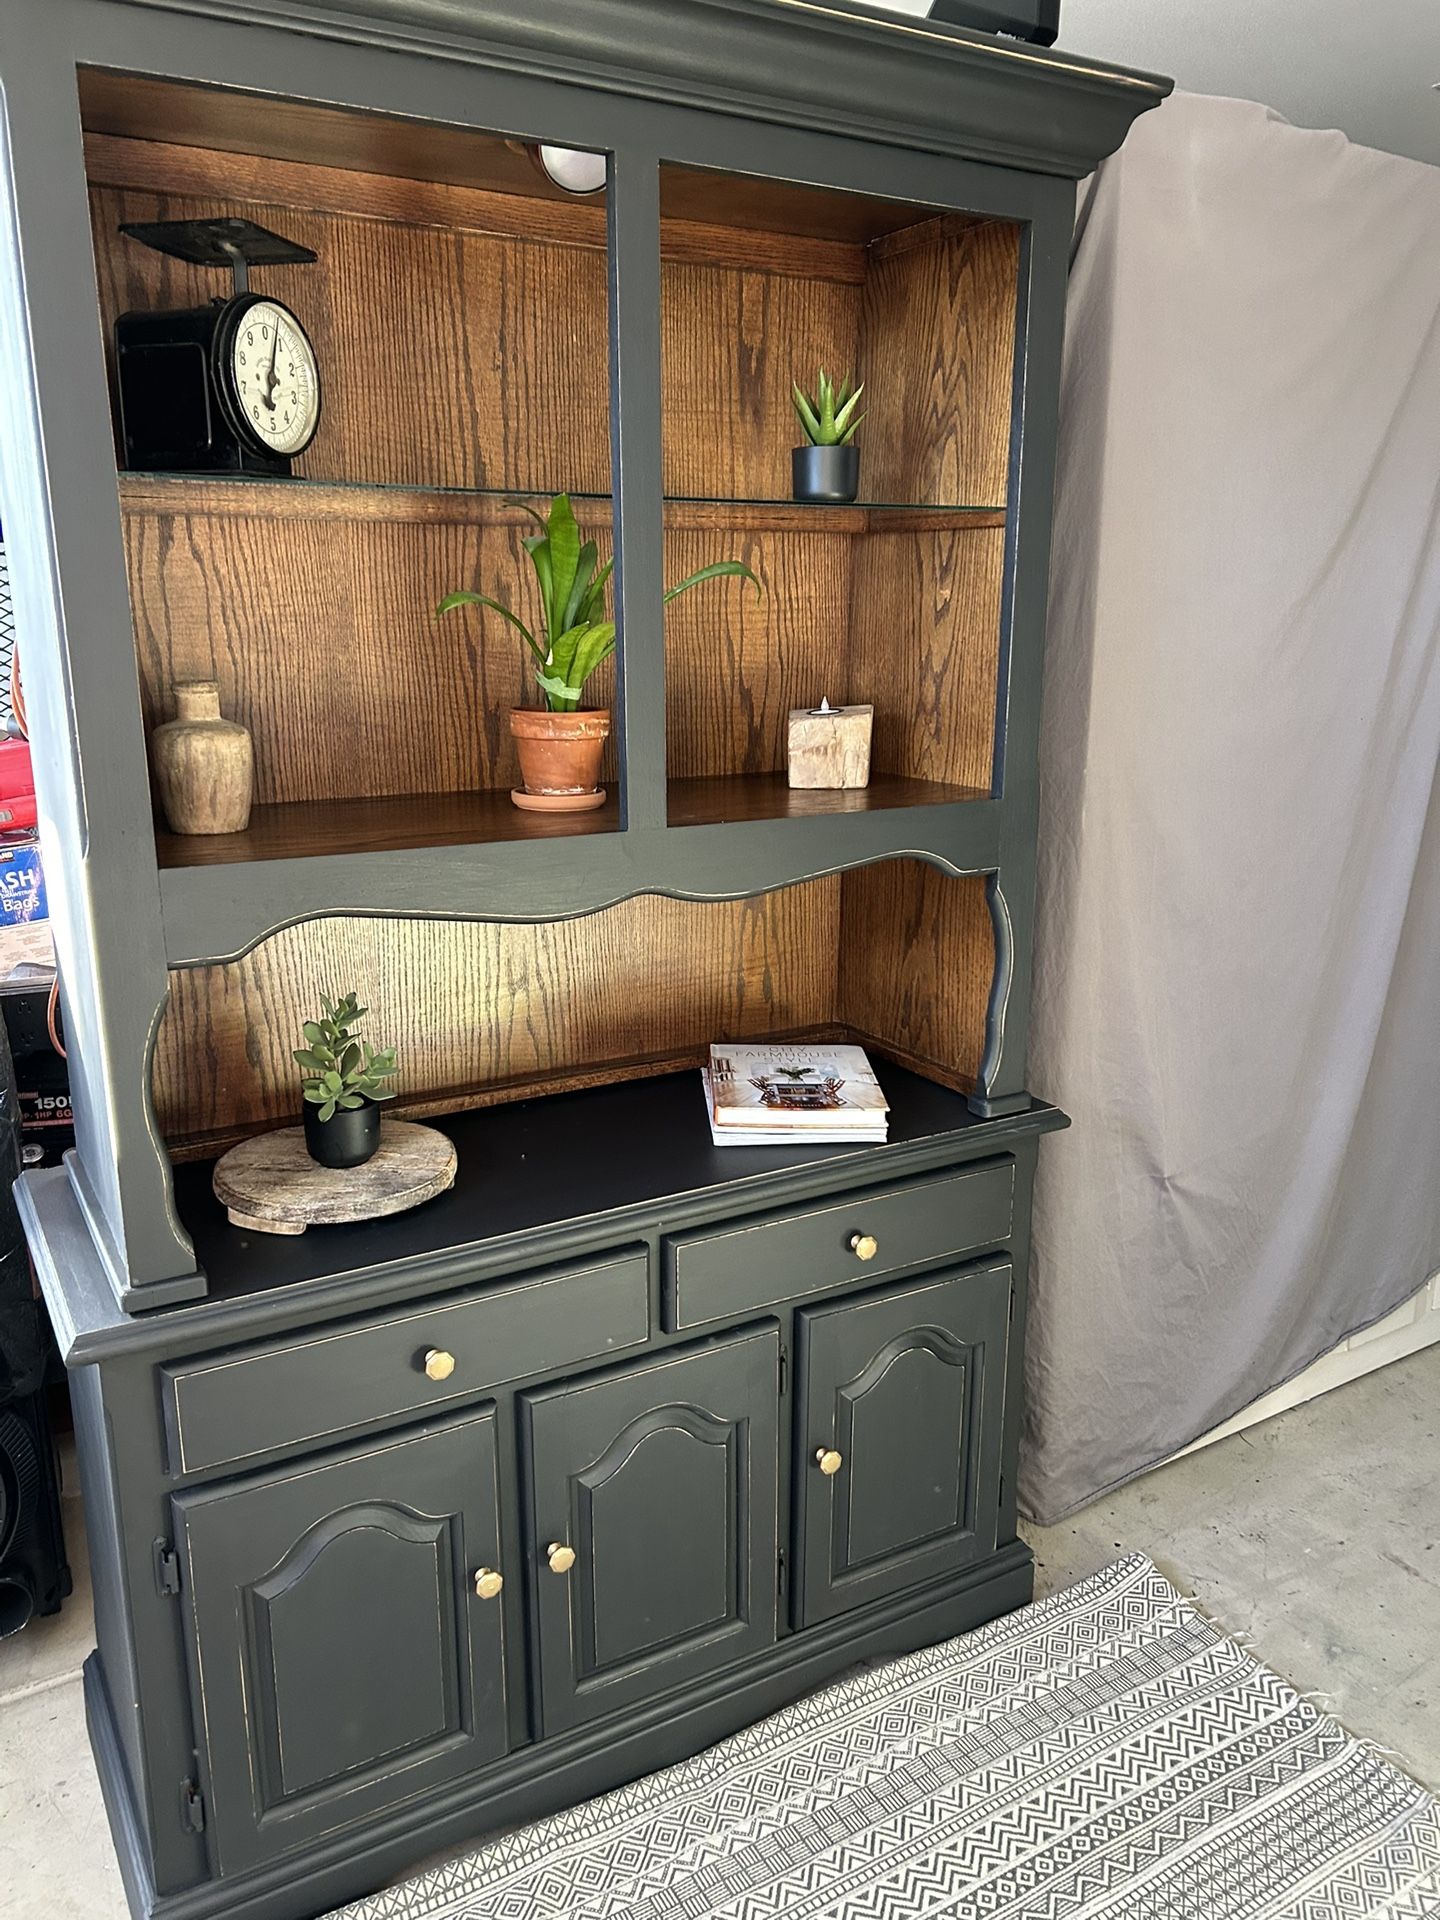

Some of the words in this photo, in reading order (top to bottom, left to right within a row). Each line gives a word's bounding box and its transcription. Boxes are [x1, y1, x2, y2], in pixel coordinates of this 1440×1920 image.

[246, 331, 254, 346] 9
[261, 326, 269, 340] 0
[278, 338, 283, 352] 1
[239, 351, 247, 366] 8
[288, 362, 295, 377] 2
[240, 381, 247, 394] 7
[291, 390, 297, 405] 3
[252, 405, 260, 419] 6
[283, 410, 290, 424] 4
[269, 417, 277, 431] 5
[3, 897, 40, 912] Bags
